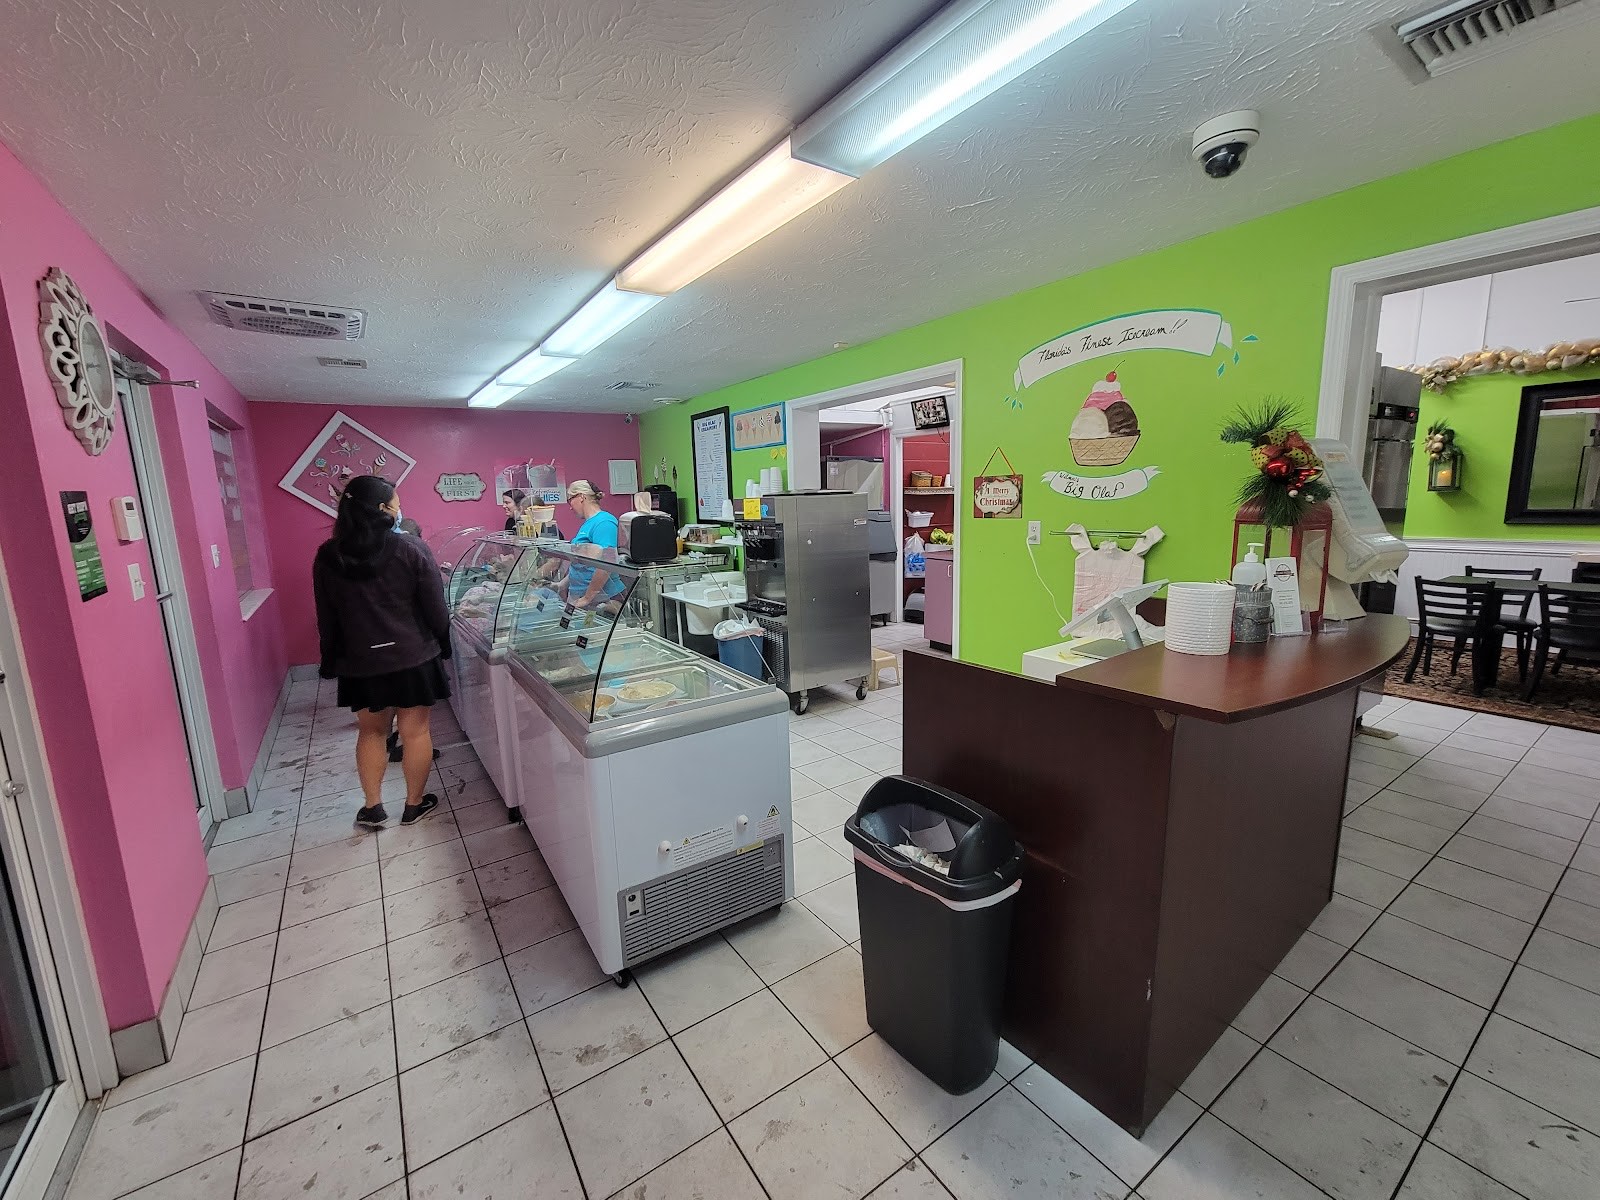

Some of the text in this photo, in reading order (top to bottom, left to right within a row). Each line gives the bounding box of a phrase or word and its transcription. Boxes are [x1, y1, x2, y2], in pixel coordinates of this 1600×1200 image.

[1038, 343, 1072, 364] Florida's
[1080, 334, 1113, 353] Finest
[443, 478, 463, 486] LIFE
[1063, 481, 1125, 500] Big Olaf
[980, 497, 1013, 507] Christmas
